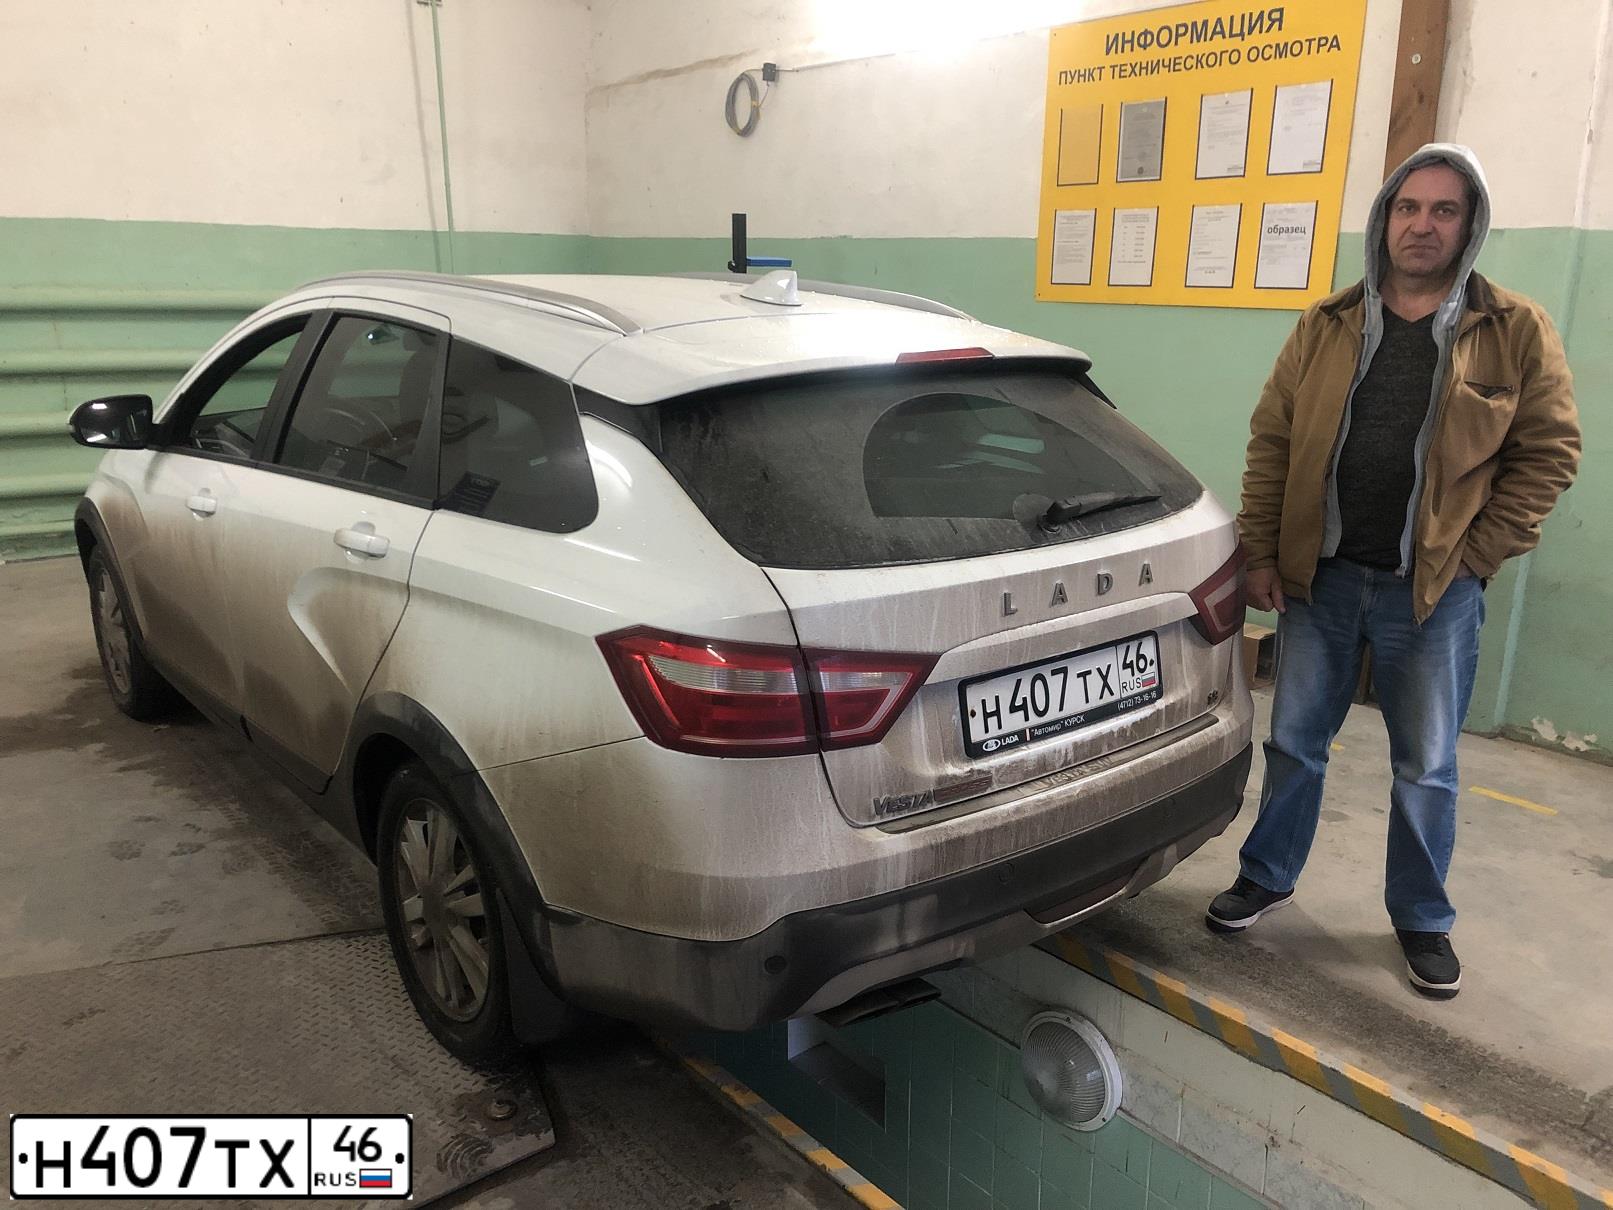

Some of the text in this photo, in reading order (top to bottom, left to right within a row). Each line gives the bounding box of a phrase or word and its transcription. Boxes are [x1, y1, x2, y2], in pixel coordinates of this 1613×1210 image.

[1105, 7, 1285, 56] ИНФОРМАЦИЯ
[1058, 34, 1341, 86] ПУНКТ ТЕХНИЧЕСКОГО ОСМОТРА
[1267, 224, 1307, 236] образец
[1003, 561, 1154, 617] LADA
[1122, 641, 1148, 677] 46
[1121, 679, 1142, 694] RUS
[1064, 714, 1086, 728] КУРСК
[1001, 734, 1019, 746] LADA
